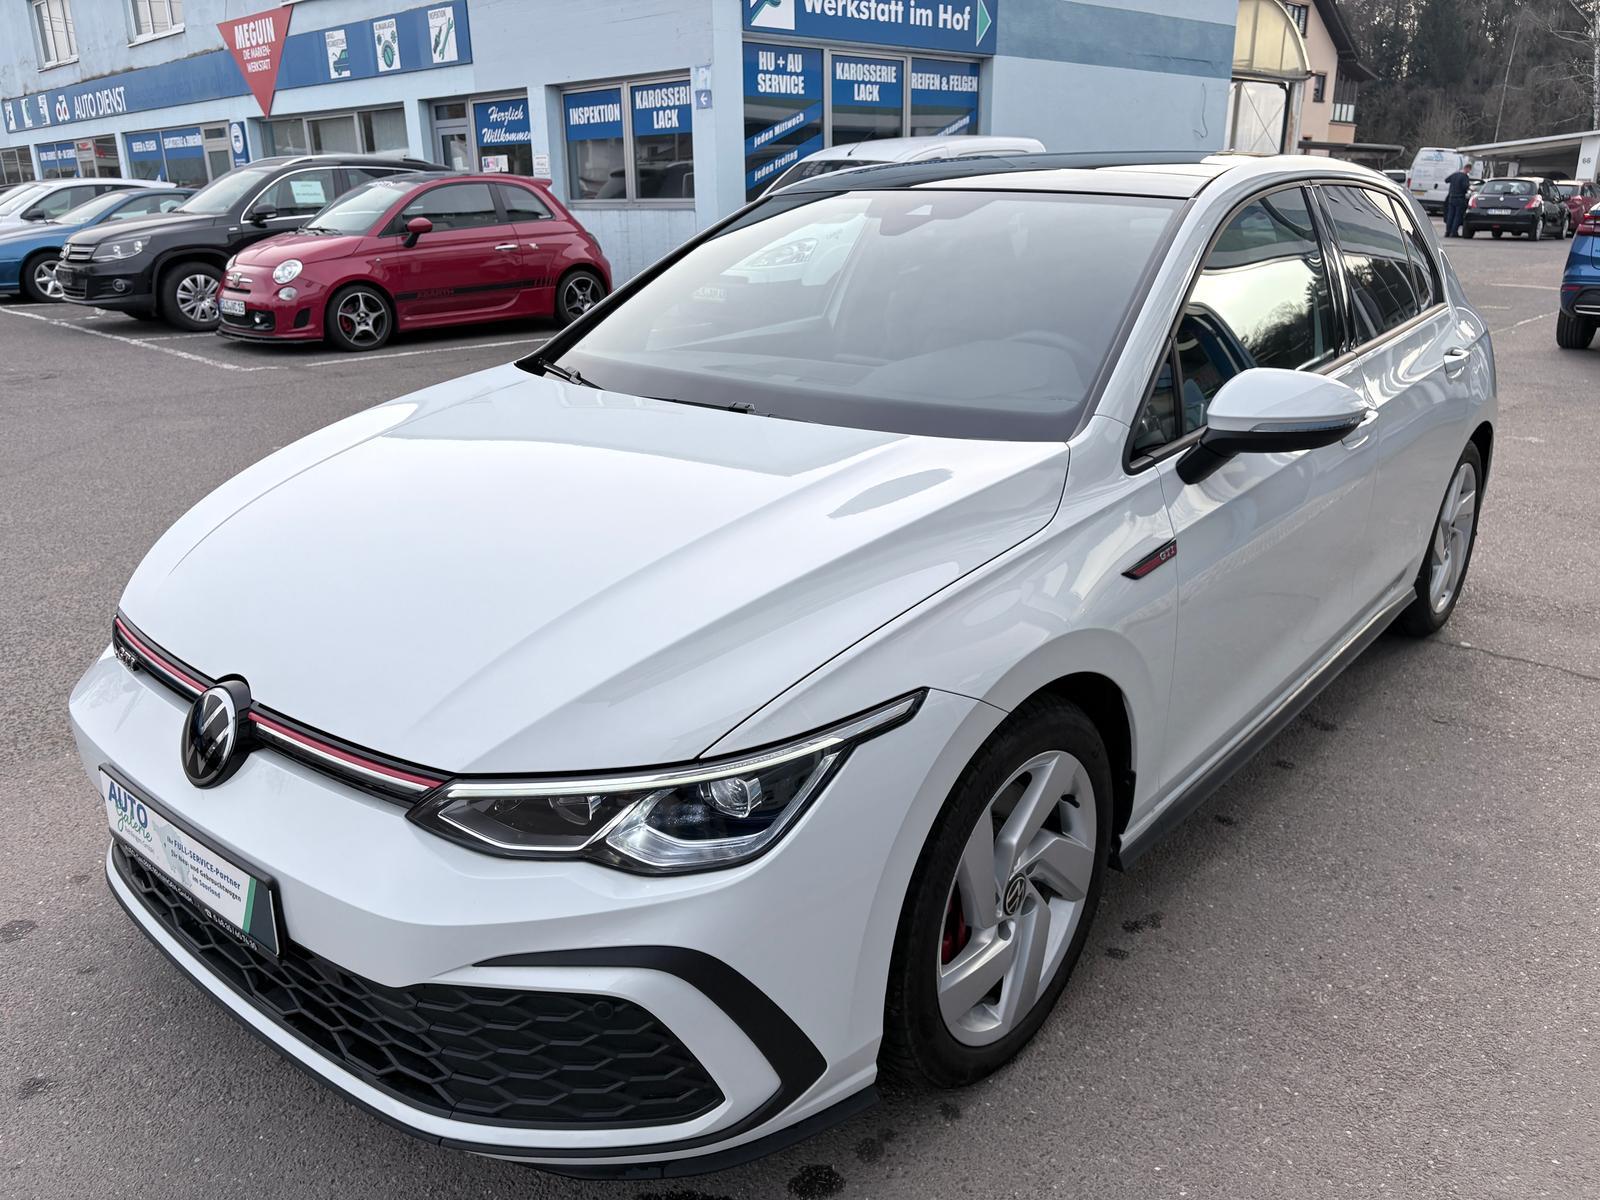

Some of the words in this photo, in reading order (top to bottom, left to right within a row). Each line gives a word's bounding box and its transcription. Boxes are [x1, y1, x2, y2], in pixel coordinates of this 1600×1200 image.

[804, 0, 904, 24] Werkstatt
[910, 2, 932, 27] im
[938, 4, 971, 31] Hof
[234, 17, 276, 50] MEGUIN
[758, 51, 775, 71] HU
[777, 56, 786, 68] +
[786, 53, 803, 73] AU
[836, 62, 897, 83] KAROSSERIE
[757, 73, 805, 95] SERVICE
[853, 83, 880, 102] LACK
[911, 73, 940, 91] REIFEN
[941, 77, 948, 90] &
[949, 75, 978, 92] FELGEN
[74, 93, 96, 120] AUTO
[96, 86, 127, 118] DIENST
[635, 86, 691, 109] KAROSSERI
[488, 104, 524, 126] Herzlich
[569, 103, 621, 125] INSPEKTION
[653, 109, 679, 129] LACK
[754, 129, 774, 148] Jeden
[774, 112, 805, 136] Mittwoch
[754, 163, 774, 182] Jeden
[775, 150, 799, 170] Freitag
[109, 781, 148, 829] AUTO
[174, 840, 241, 890] FULL-SERVICE-Partner
